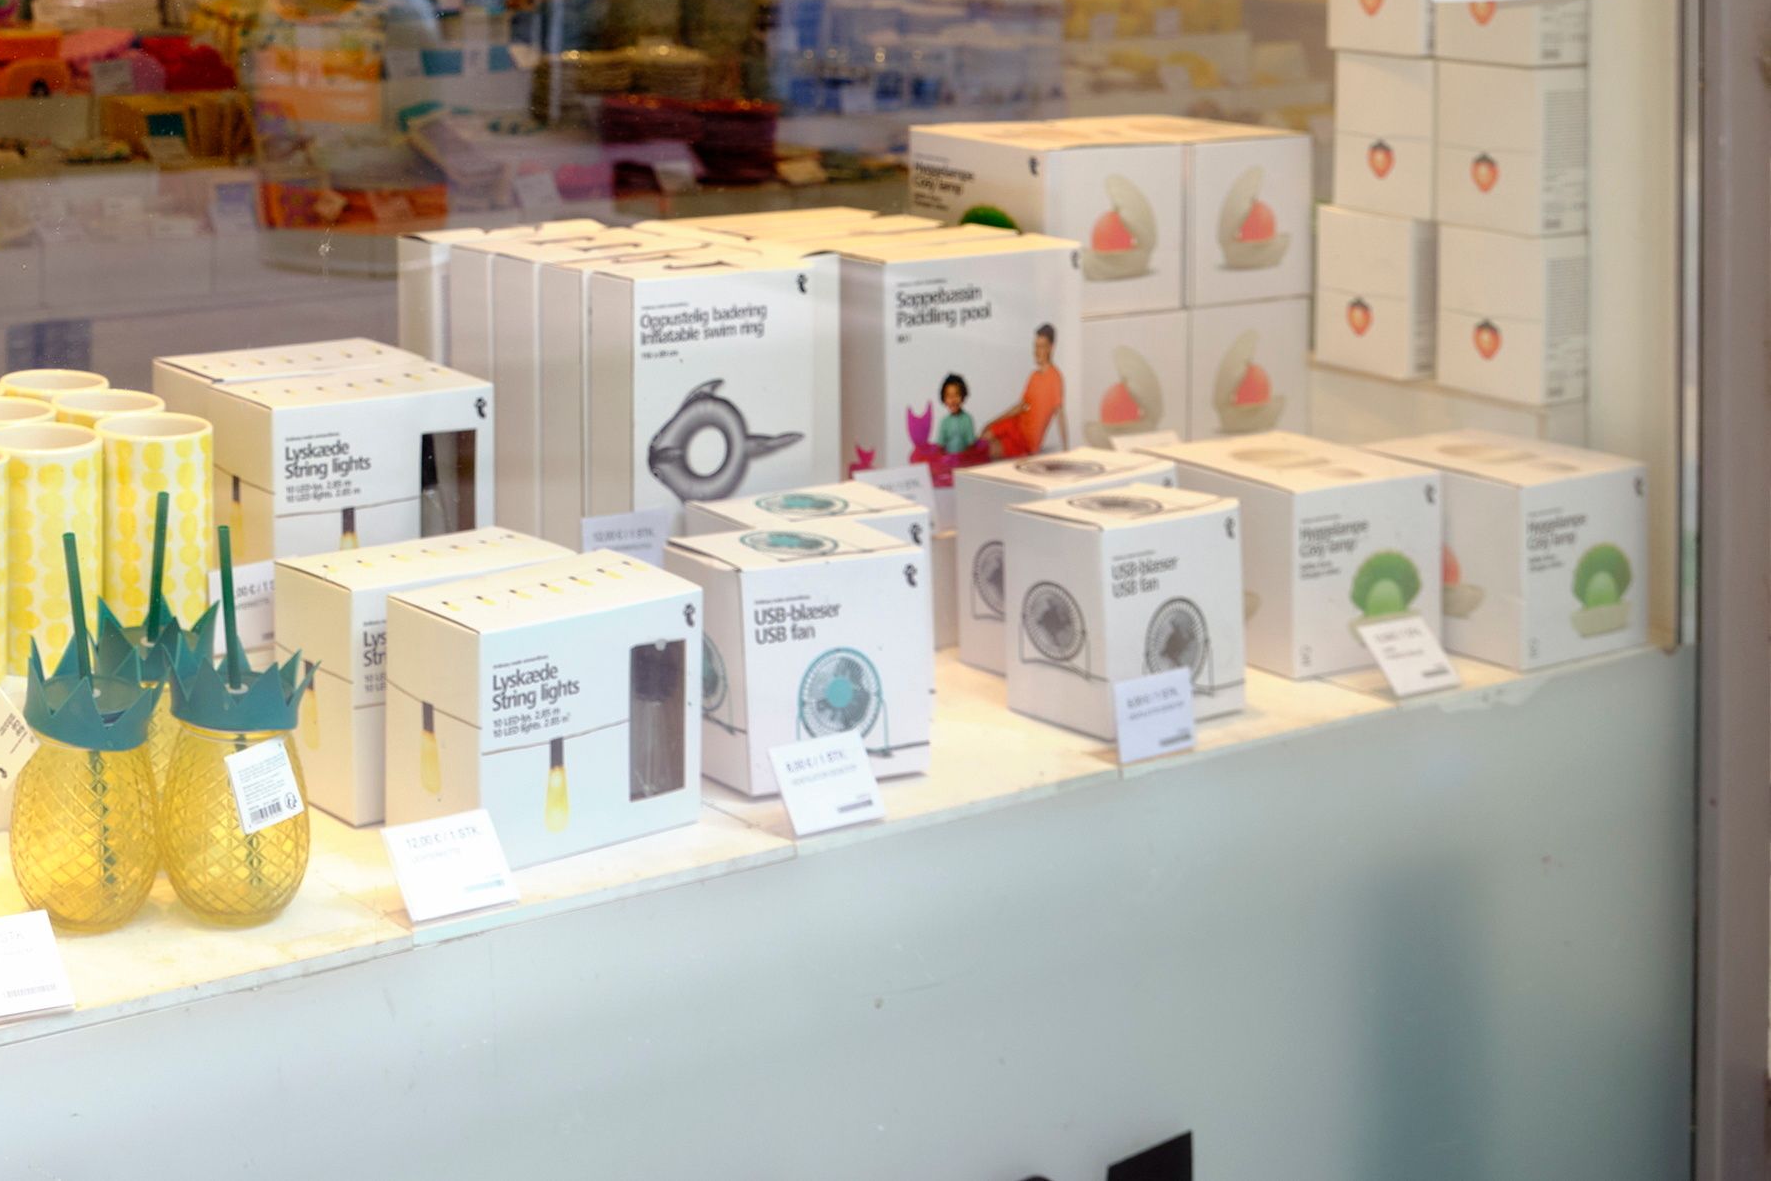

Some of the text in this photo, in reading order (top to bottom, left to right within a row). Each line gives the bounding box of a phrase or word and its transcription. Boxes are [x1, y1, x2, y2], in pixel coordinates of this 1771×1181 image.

[896, 302, 992, 328] Paddling pool
[285, 455, 372, 480] String lights
[755, 622, 816, 645] USB fan
[492, 662, 559, 695] Lyskæde
[492, 680, 580, 712] String lights
